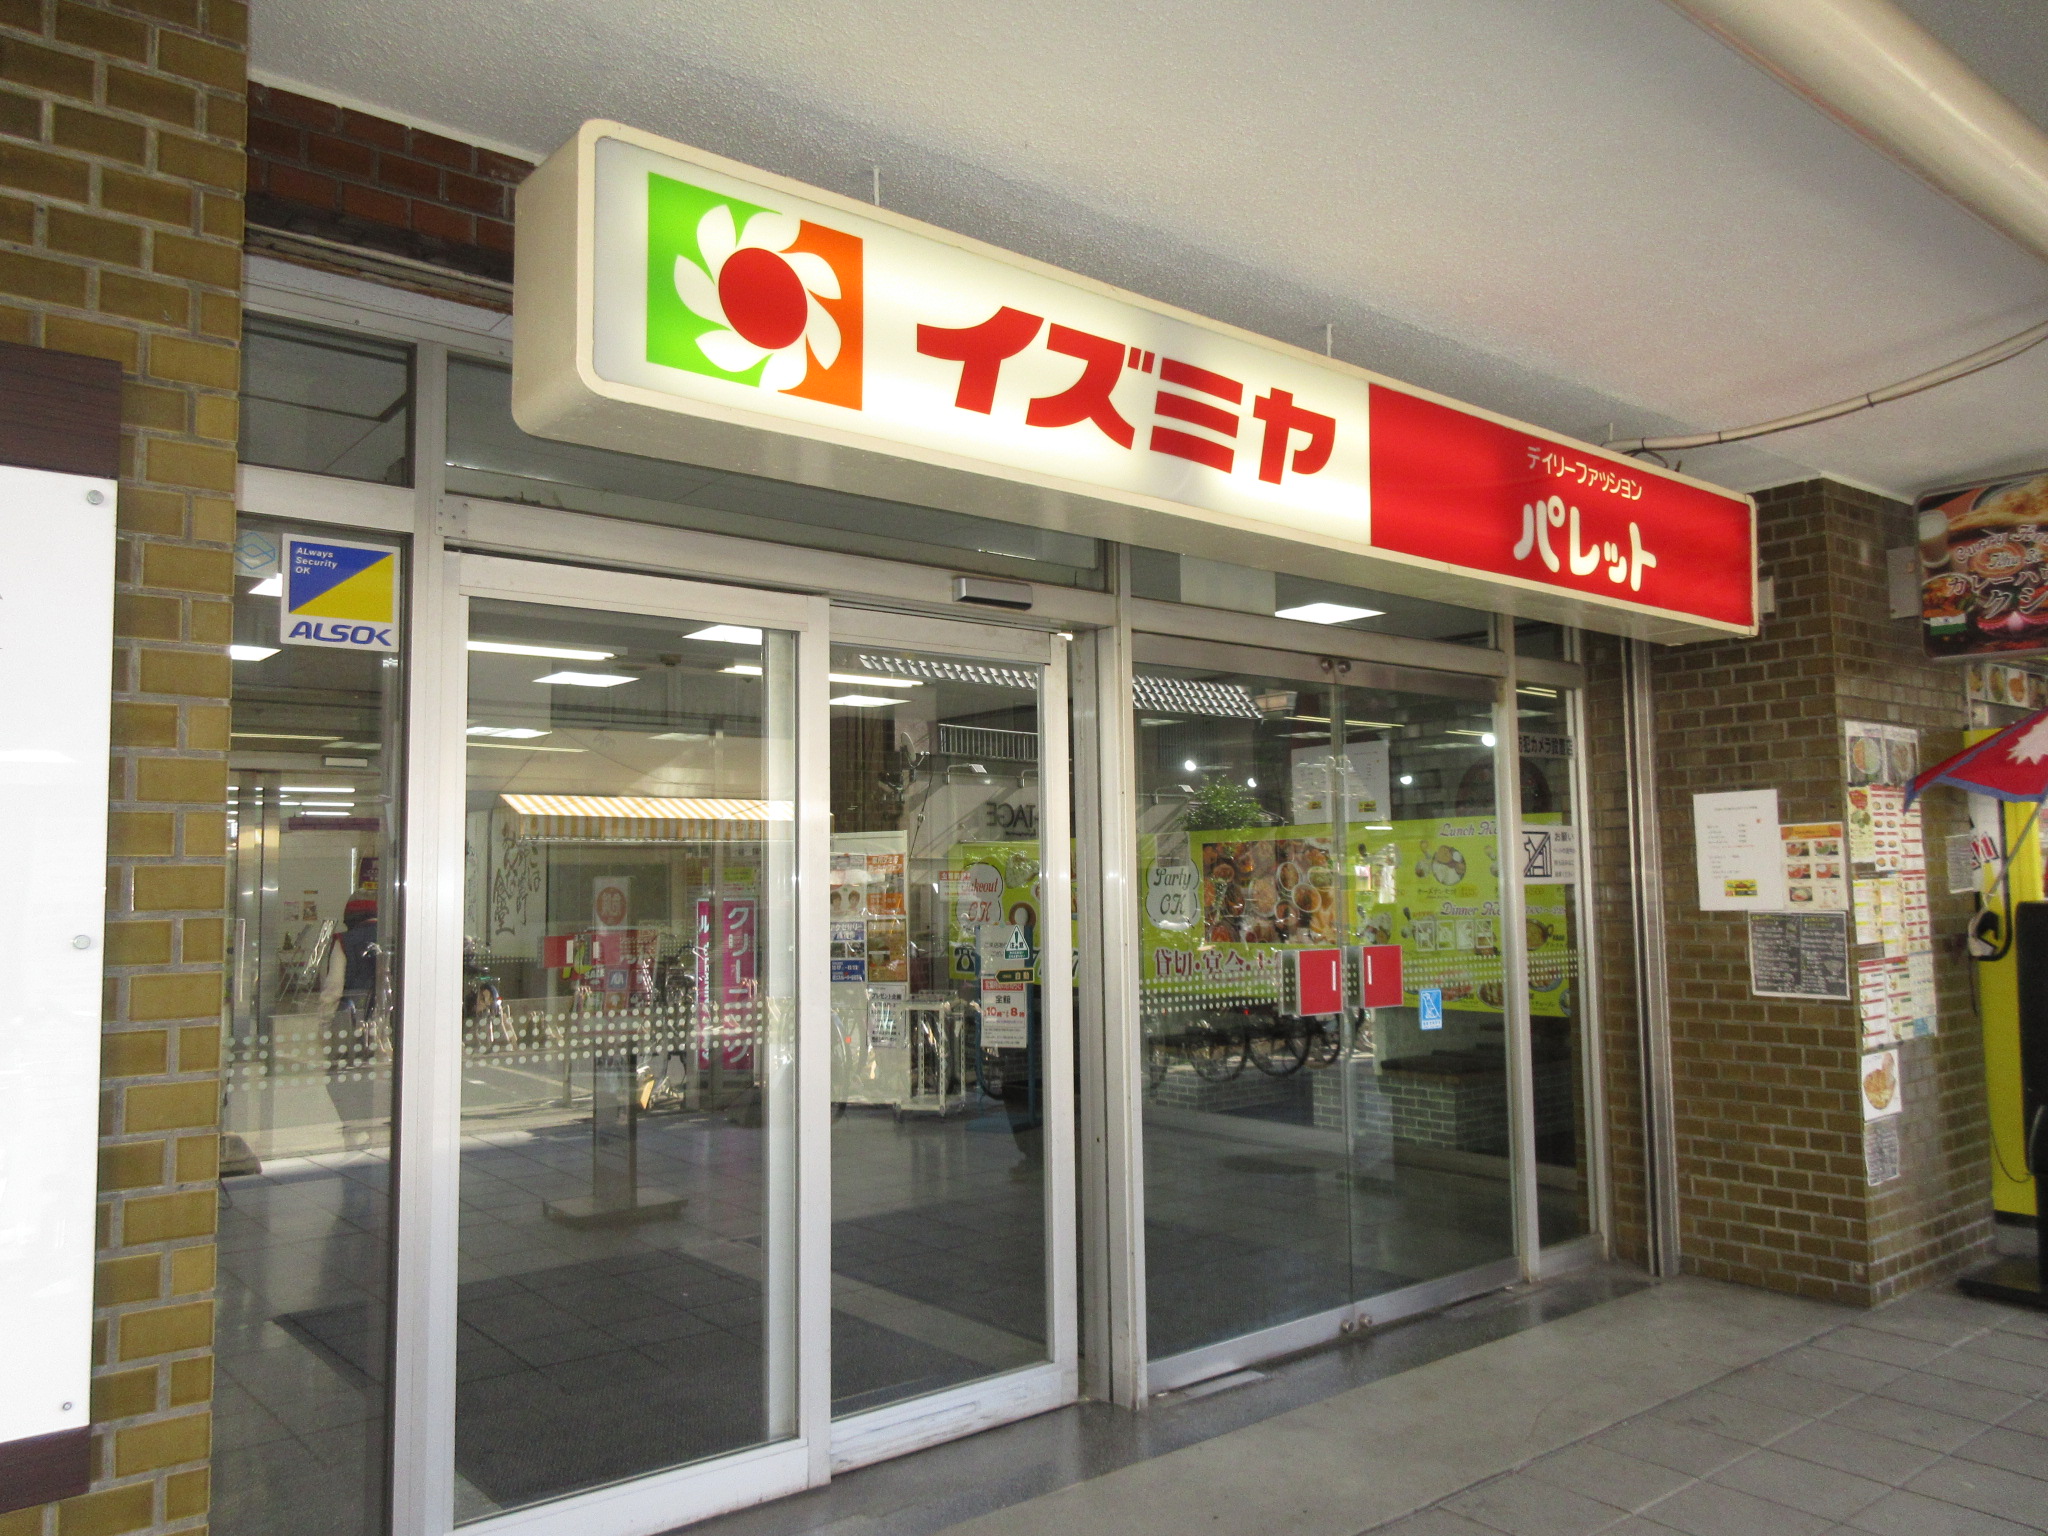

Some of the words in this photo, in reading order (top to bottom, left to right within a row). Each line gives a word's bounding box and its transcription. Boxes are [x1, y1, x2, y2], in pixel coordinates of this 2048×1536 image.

[917, 306, 1337, 485] イズミヤ
[1513, 495, 1657, 592] パレット
[295, 557, 338, 569] Security
[289, 621, 392, 647] ALSOK
[1440, 822, 1475, 837] Lunch
[1153, 868, 1191, 890] Party
[1160, 894, 1185, 915] OK
[1440, 901, 1478, 916] Dinner
[1015, 971, 1030, 980] 自動
